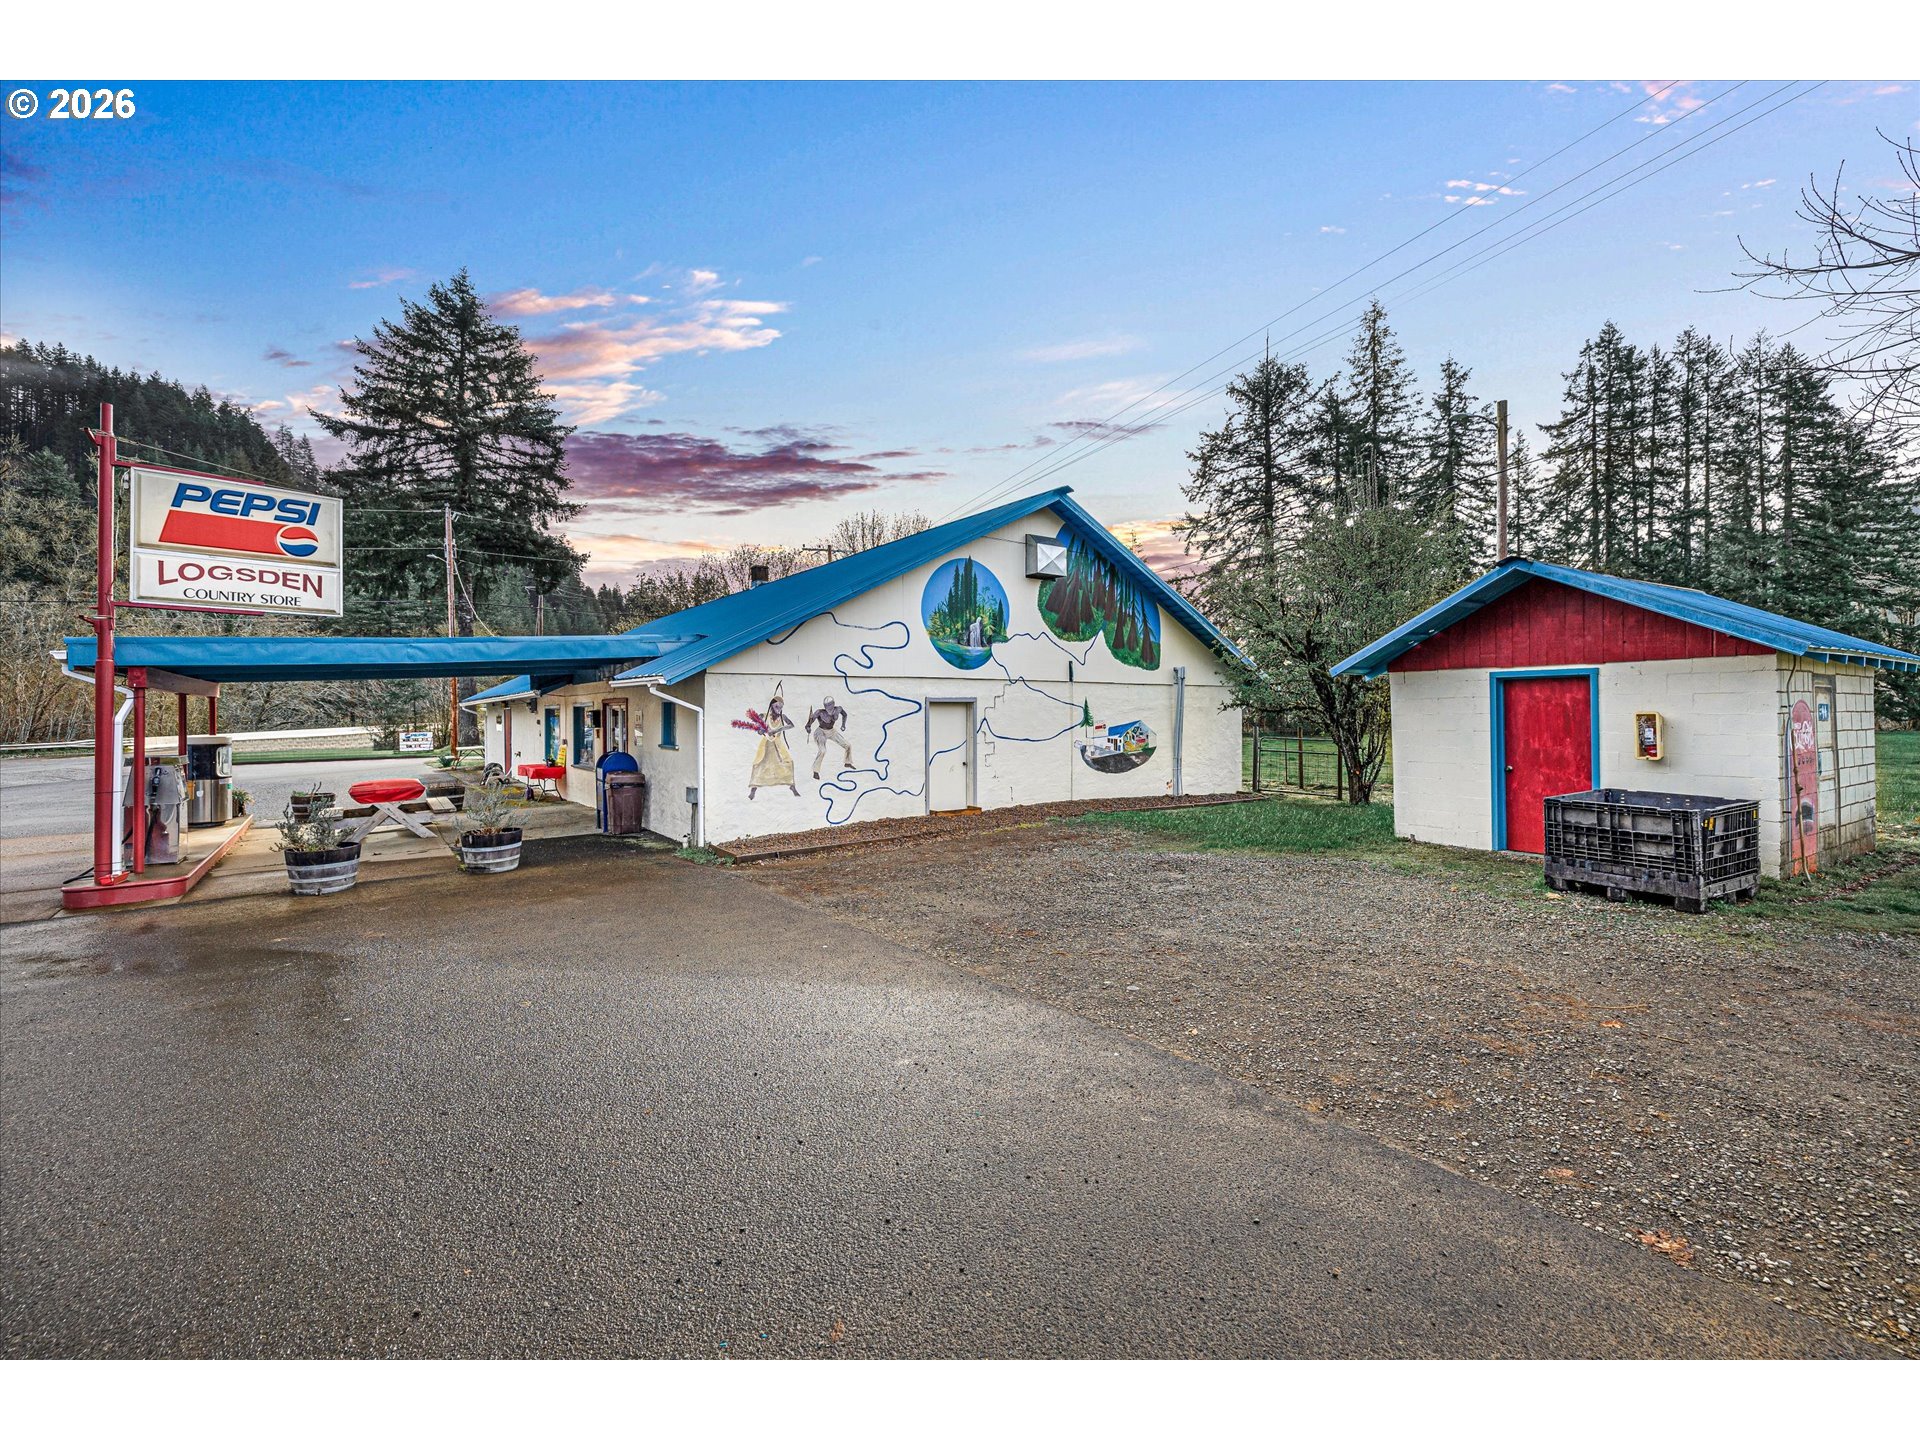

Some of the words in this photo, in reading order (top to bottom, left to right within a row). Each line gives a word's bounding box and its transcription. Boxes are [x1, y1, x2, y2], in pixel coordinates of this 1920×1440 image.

[171, 483, 321, 526] PEPSI
[158, 560, 323, 599] LOGSDEN
[183, 587, 256, 603] COUNTRY
[260, 594, 301, 606] STORE
